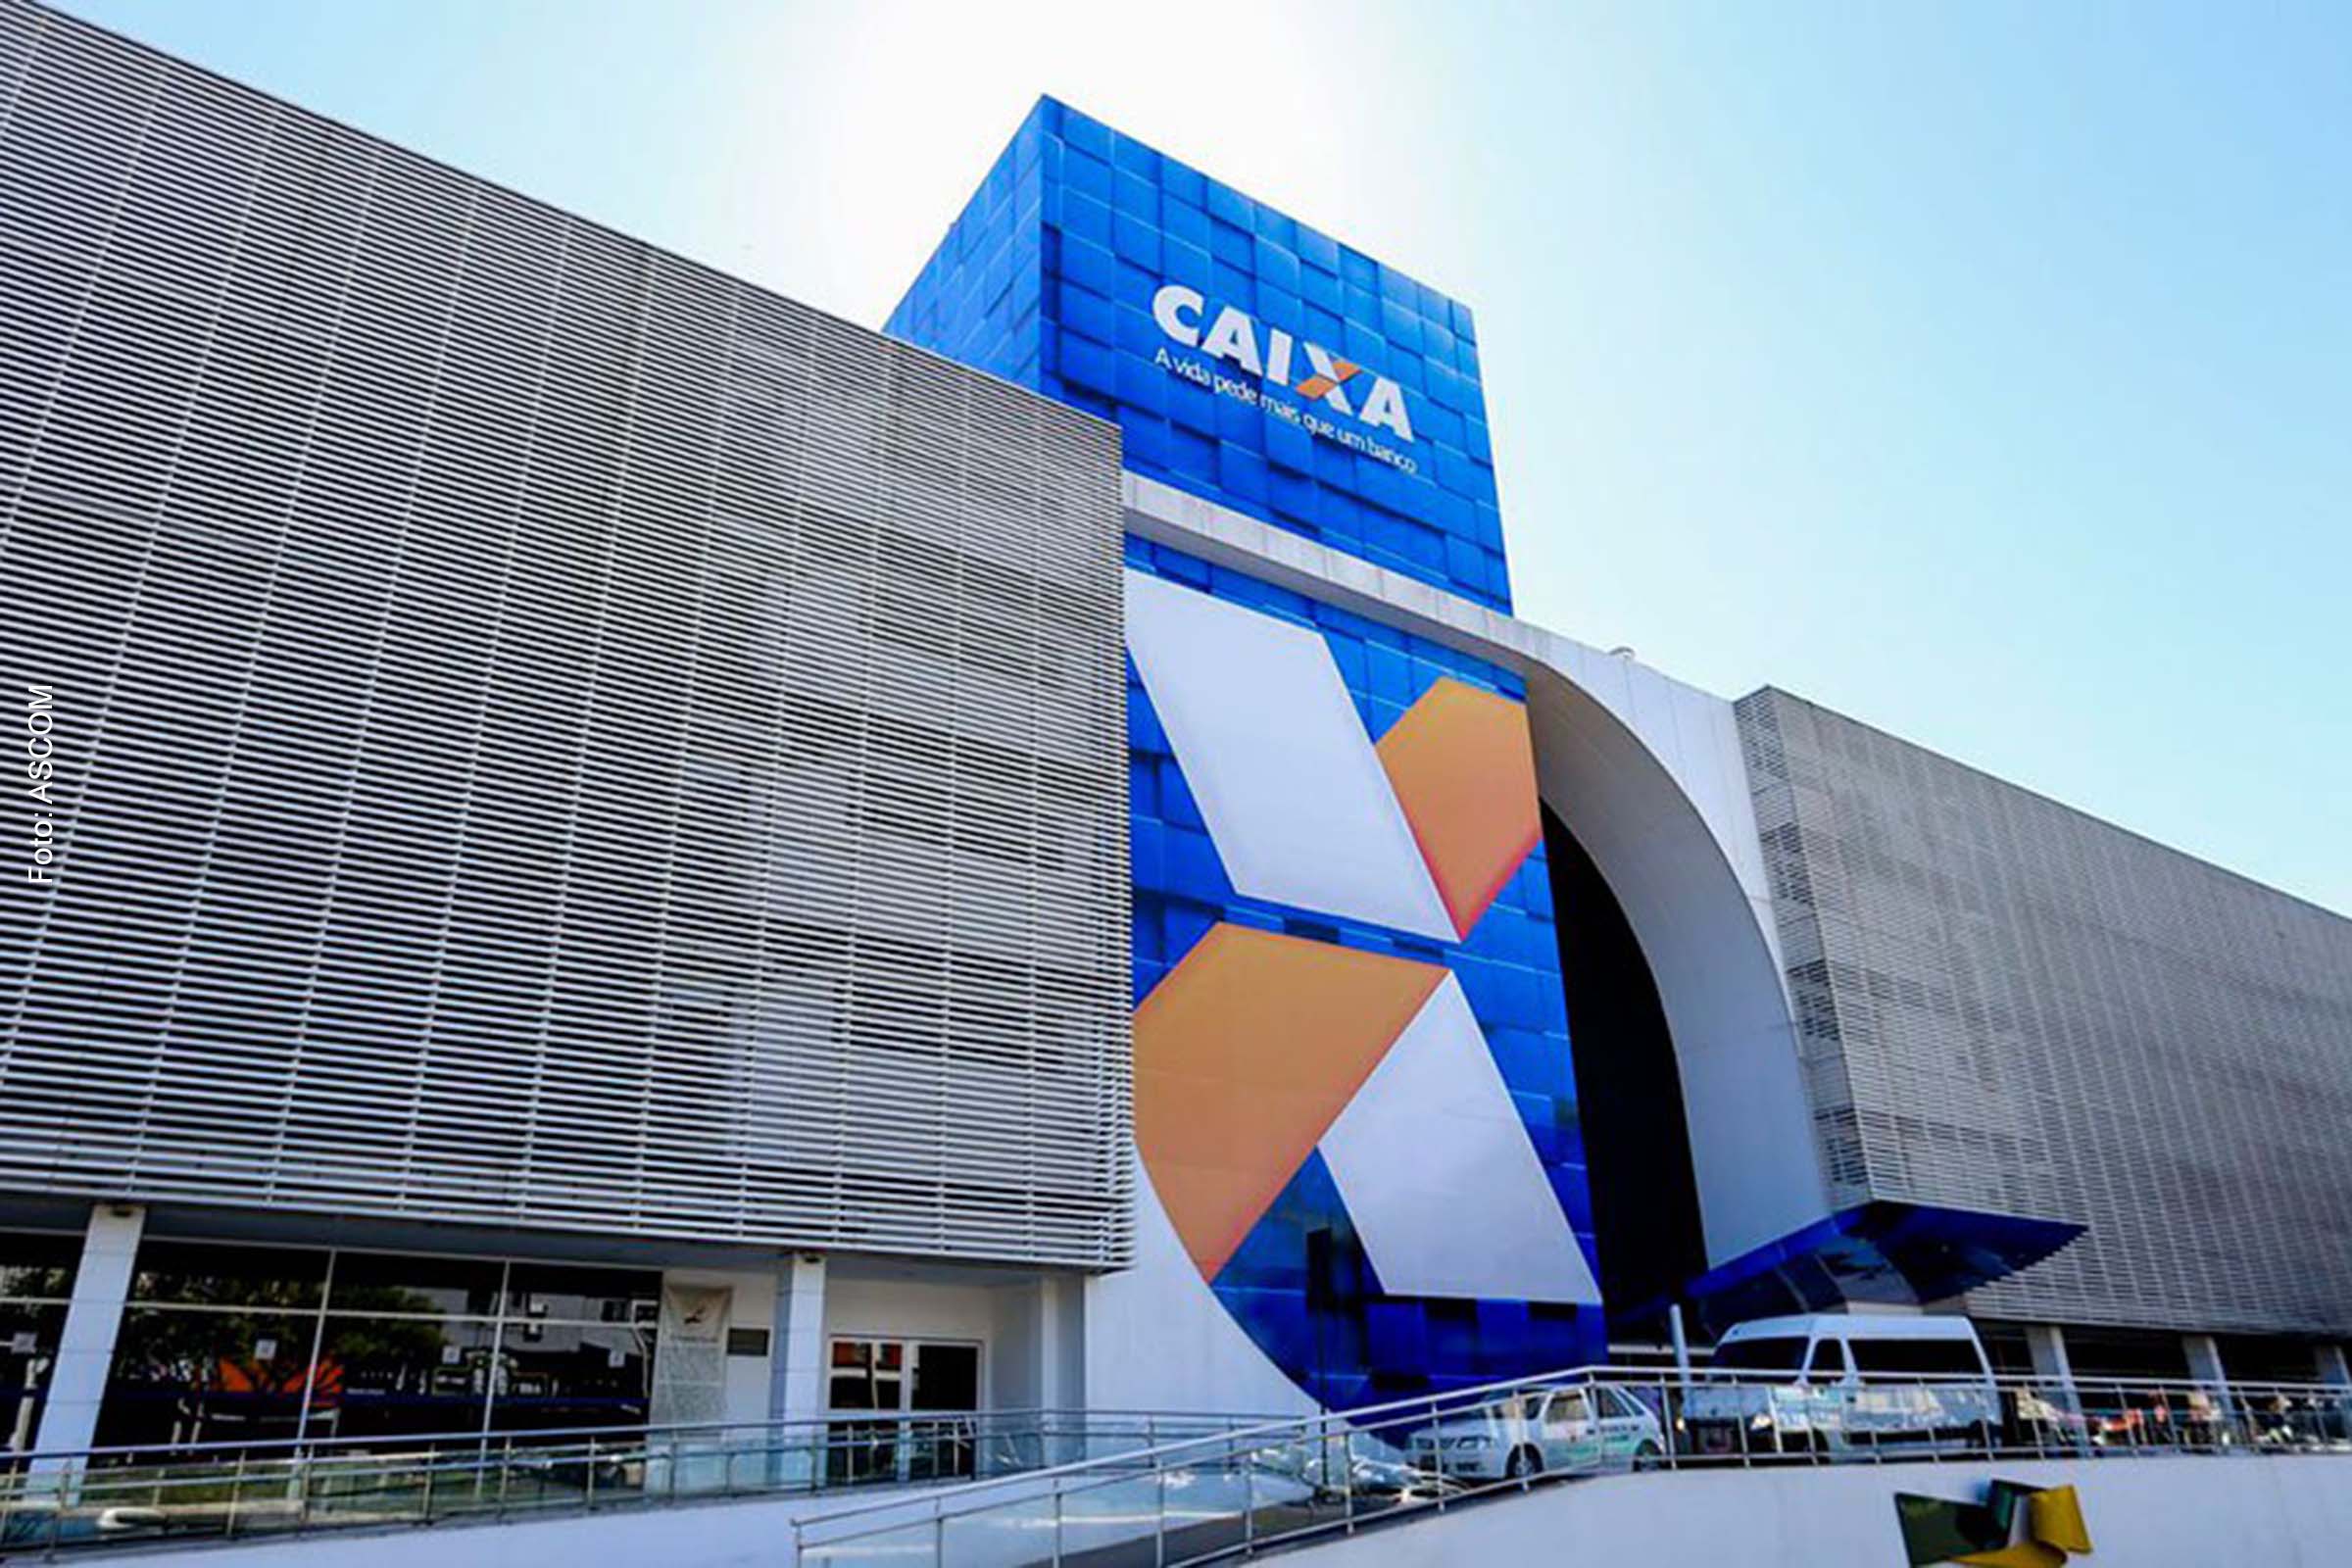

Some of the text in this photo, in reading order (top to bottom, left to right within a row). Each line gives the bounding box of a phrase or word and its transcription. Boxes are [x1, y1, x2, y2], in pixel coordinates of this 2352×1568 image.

[1152, 285, 1414, 443] CAIXA
[1154, 347, 1173, 369] A
[1172, 356, 1211, 386] vida
[1213, 374, 1258, 406] pede
[1302, 413, 1335, 438] que
[1336, 428, 1367, 453] um
[1367, 436, 1417, 474] banco
